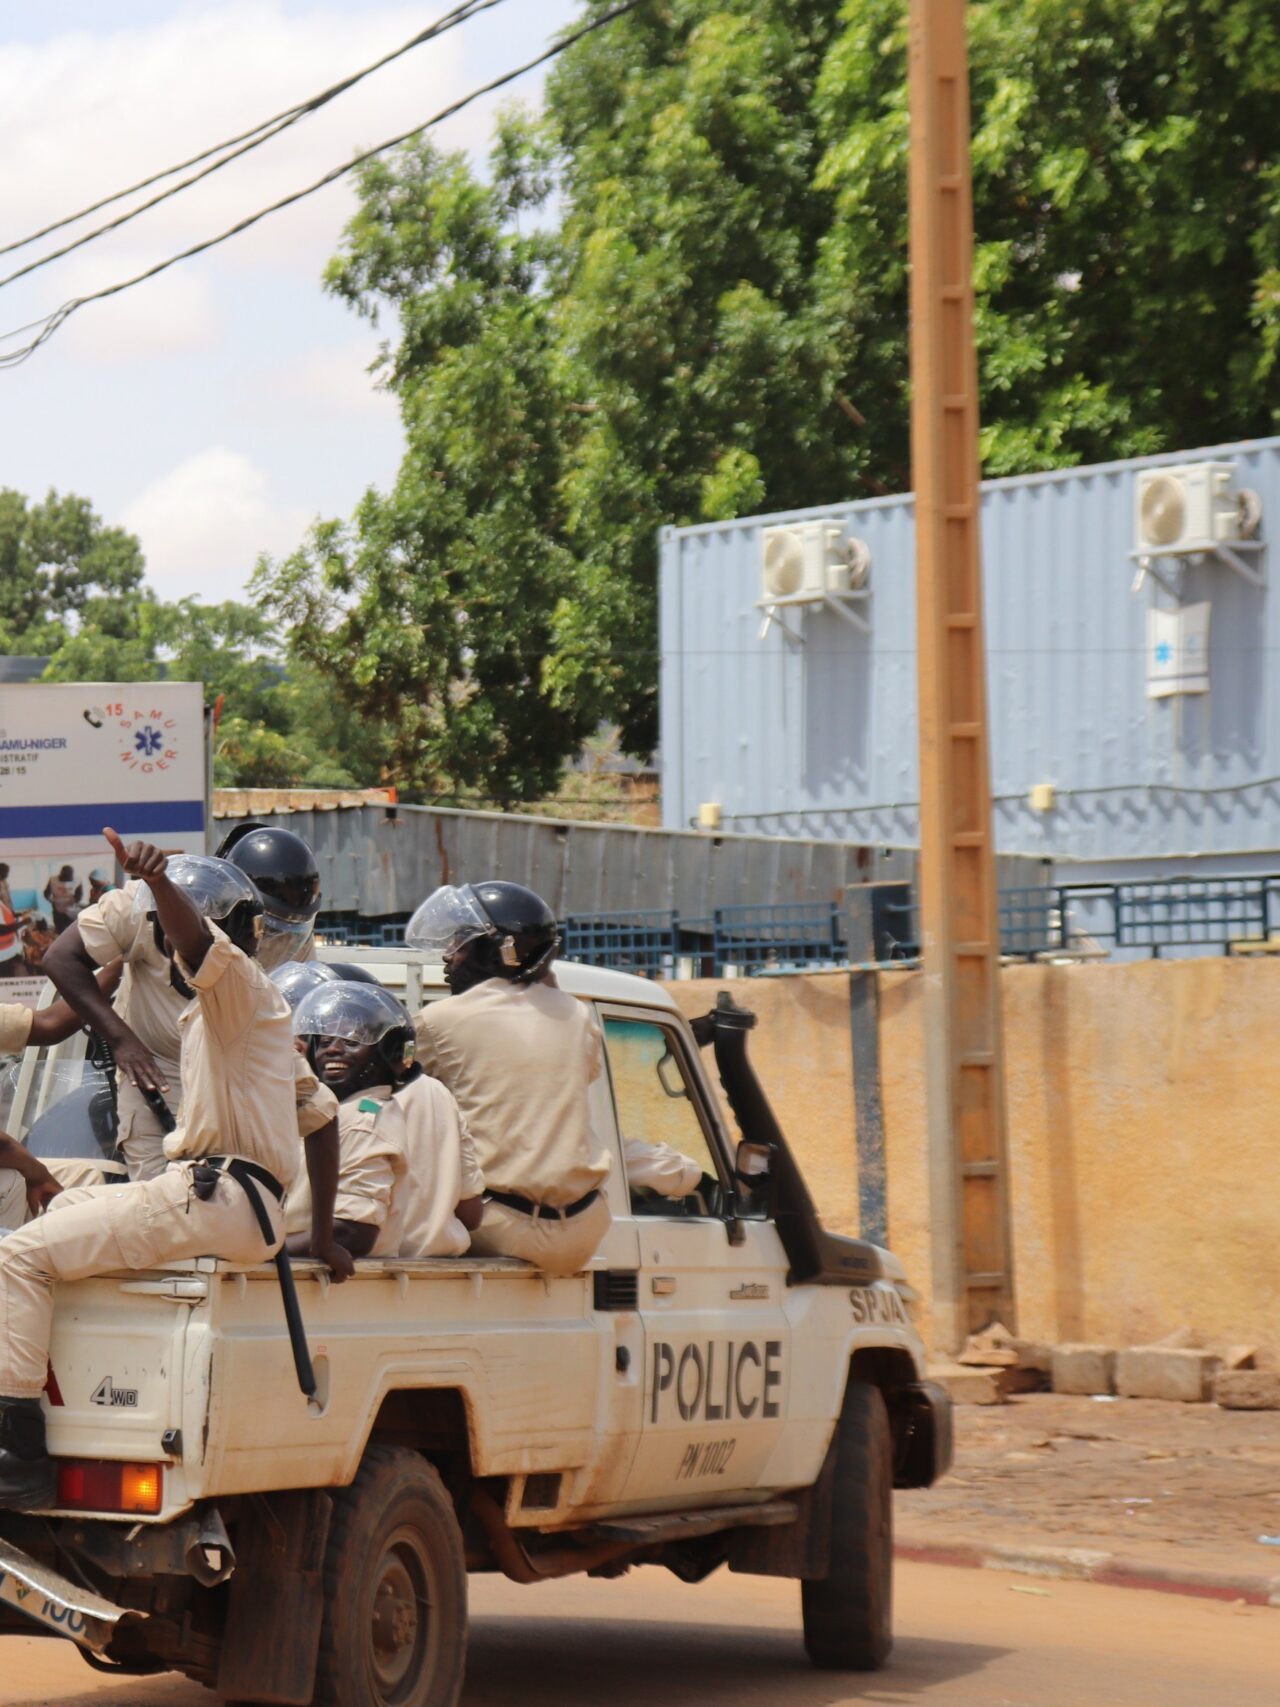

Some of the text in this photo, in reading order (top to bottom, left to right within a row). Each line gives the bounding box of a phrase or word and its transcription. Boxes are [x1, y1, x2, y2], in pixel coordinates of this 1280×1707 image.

[106, 703, 124, 717] 15
[120, 709, 176, 729] SAMU
[120, 749, 178, 773] NIGER
[89, 1375, 138, 1407] 4WD
[651, 1340, 783, 1424] POLICE
